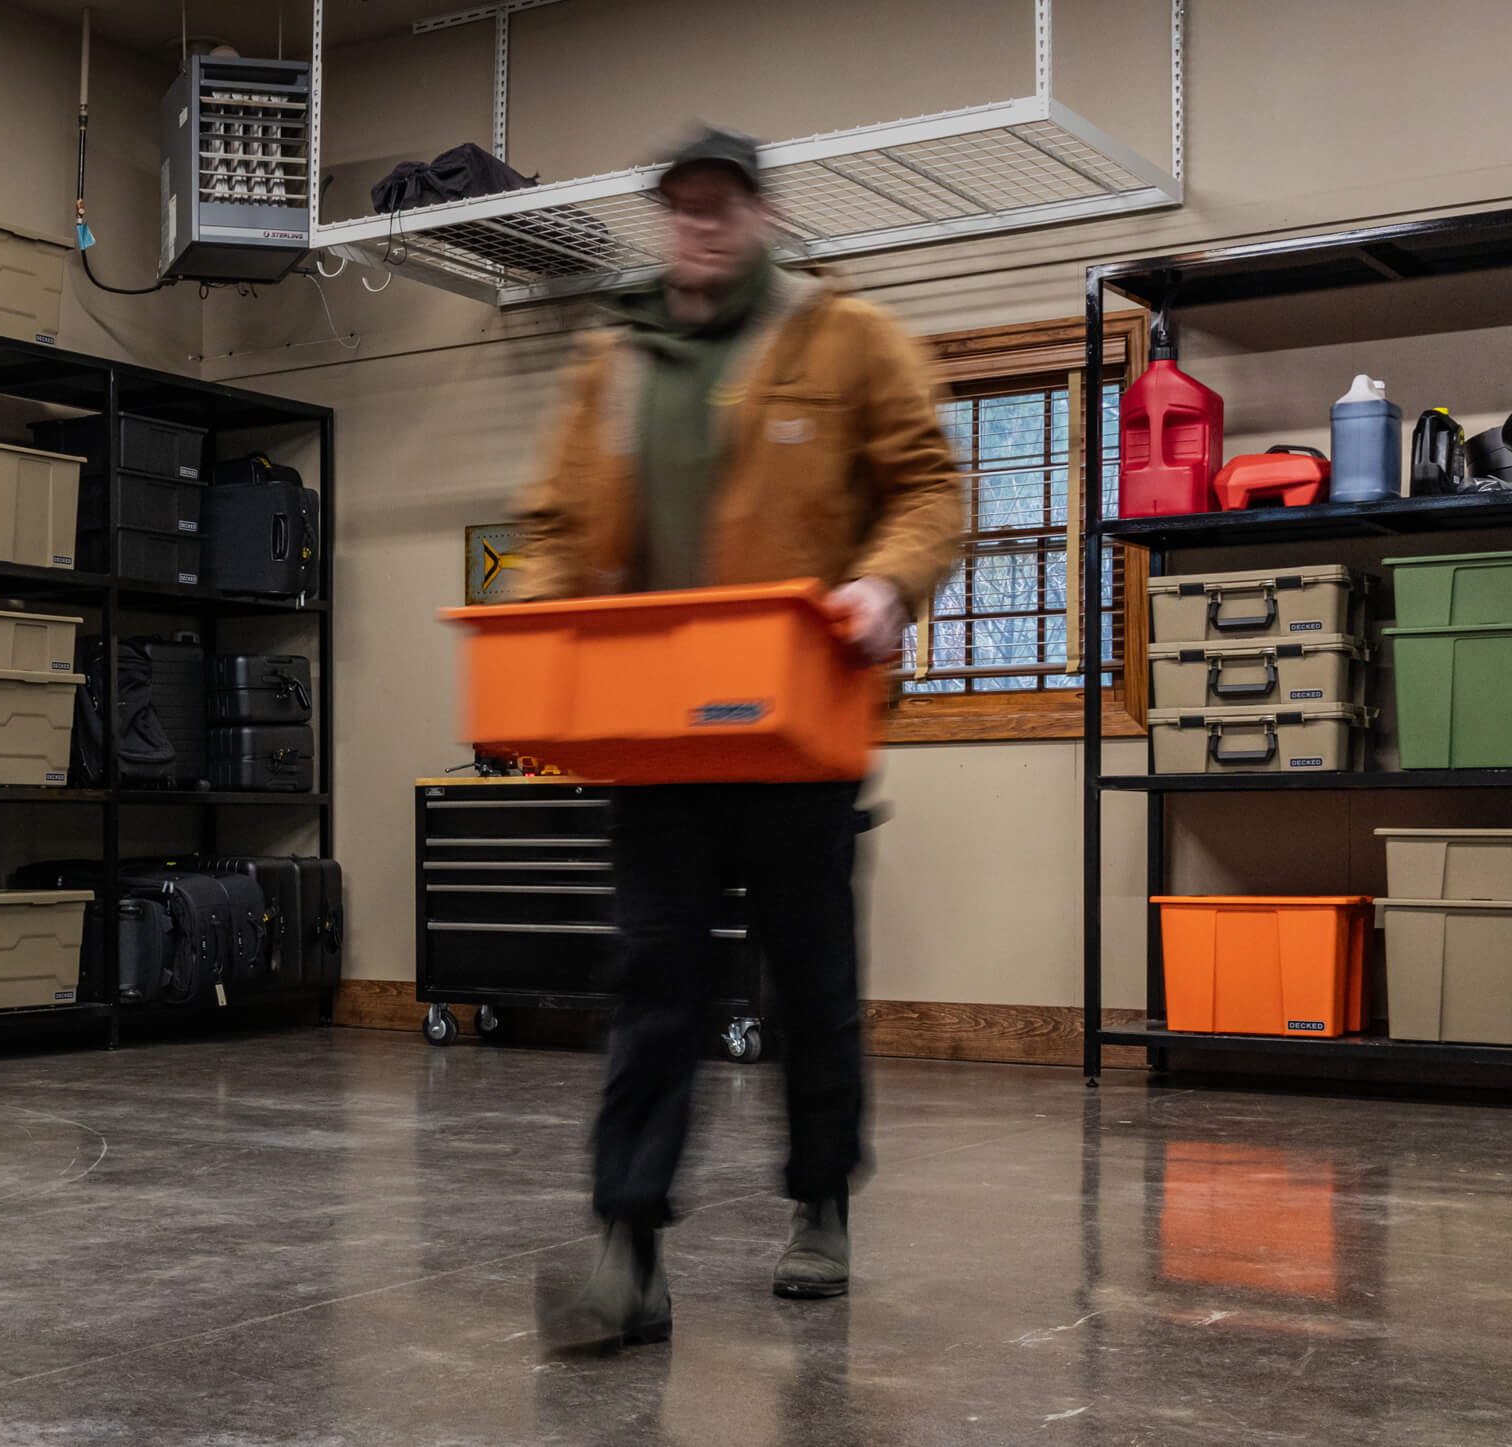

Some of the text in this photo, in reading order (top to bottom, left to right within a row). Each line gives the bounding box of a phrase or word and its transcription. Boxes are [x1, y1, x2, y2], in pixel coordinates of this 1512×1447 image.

[1290, 623, 1321, 631] DECKED
[1291, 691, 1321, 699] DECKED
[1290, 759, 1321, 767] DECKED
[1289, 1022, 1323, 1030] DECKED
